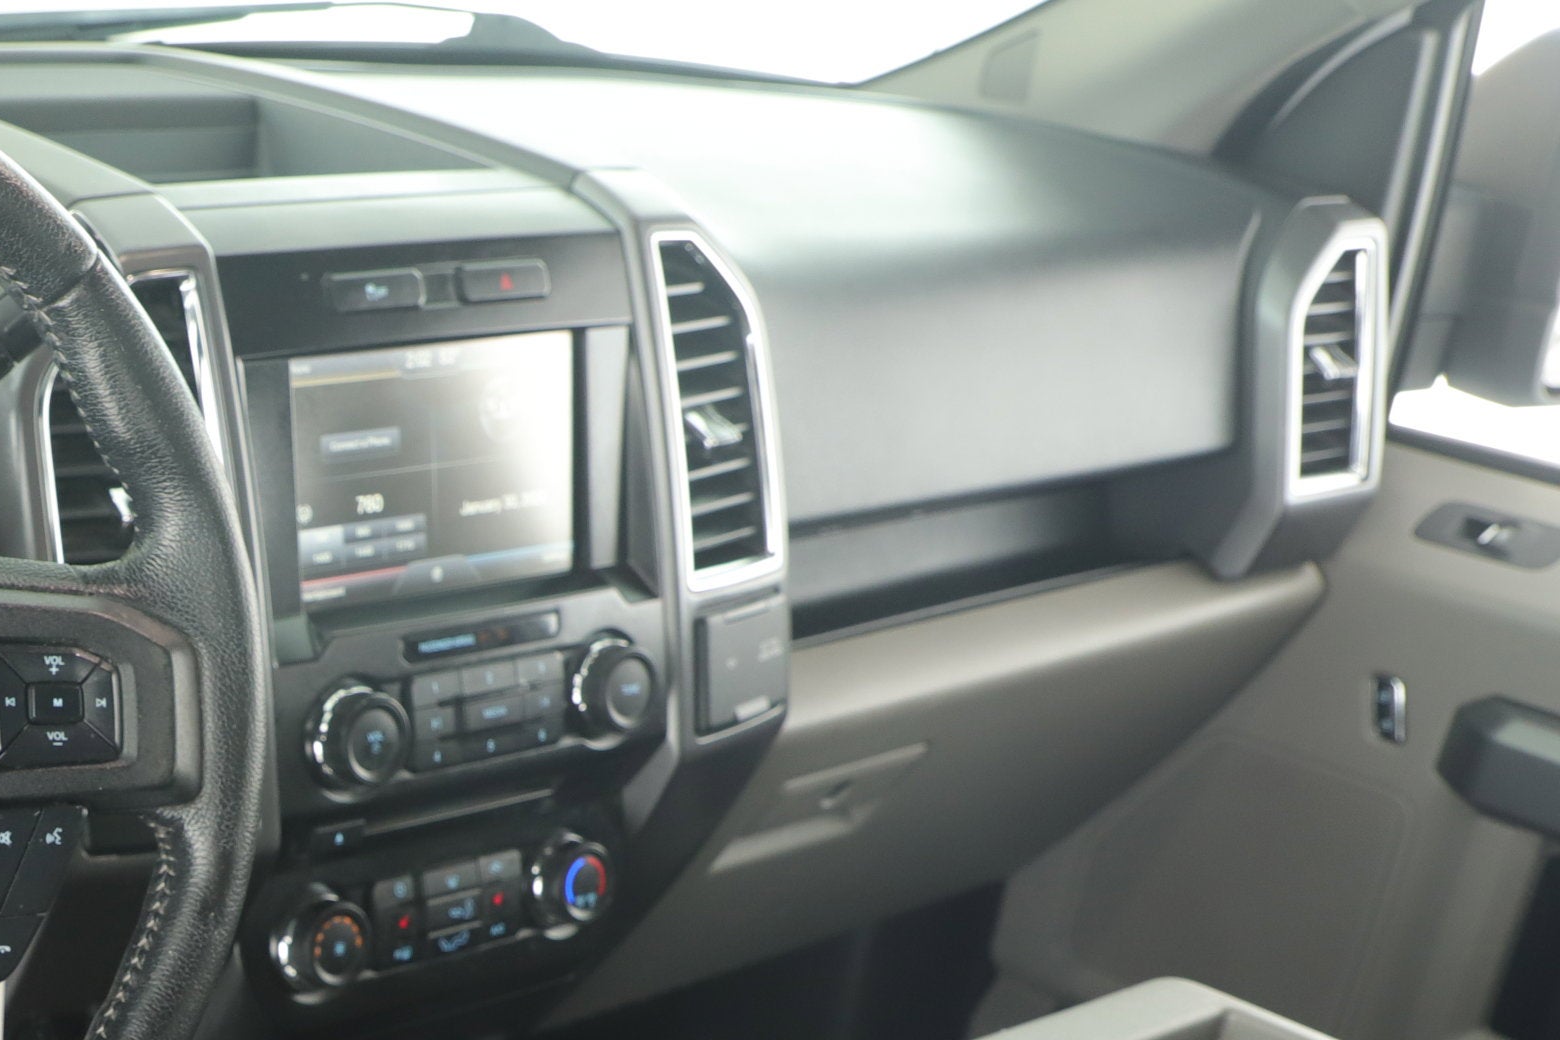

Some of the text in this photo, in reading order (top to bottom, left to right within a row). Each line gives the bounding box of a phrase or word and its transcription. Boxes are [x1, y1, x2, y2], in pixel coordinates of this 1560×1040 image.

[43, 655, 65, 665] VOL
[53, 698, 63, 707] M
[45, 731, 68, 741] VOL
